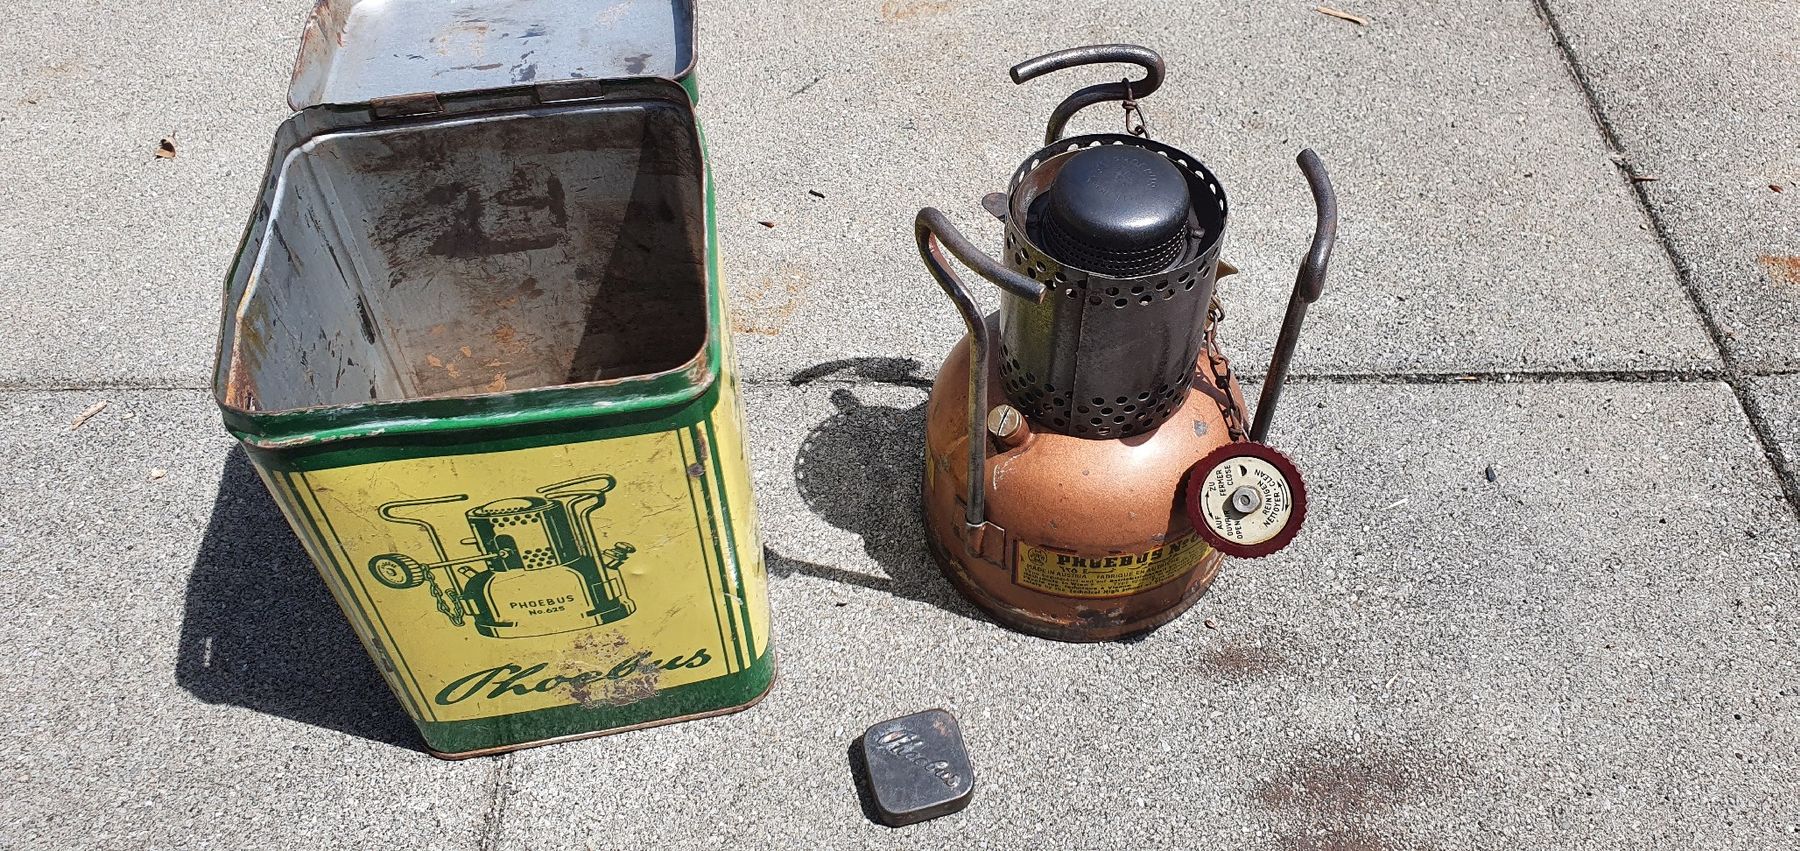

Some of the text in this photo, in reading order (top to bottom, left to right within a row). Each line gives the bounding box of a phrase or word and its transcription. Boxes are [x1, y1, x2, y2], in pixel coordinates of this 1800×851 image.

[1215, 469, 1227, 496] FERMER
[1224, 464, 1234, 486] CLOSE
[1209, 481, 1217, 492] ZU
[1257, 480, 1272, 515] REINIGEN
[1254, 469, 1281, 528] NETTOYER CLEAN
[1215, 515, 1223, 530] AUF
[1234, 520, 1243, 539] OPEN
[510, 594, 575, 609] PHOEBUS
[434, 647, 712, 706] Phoebus
